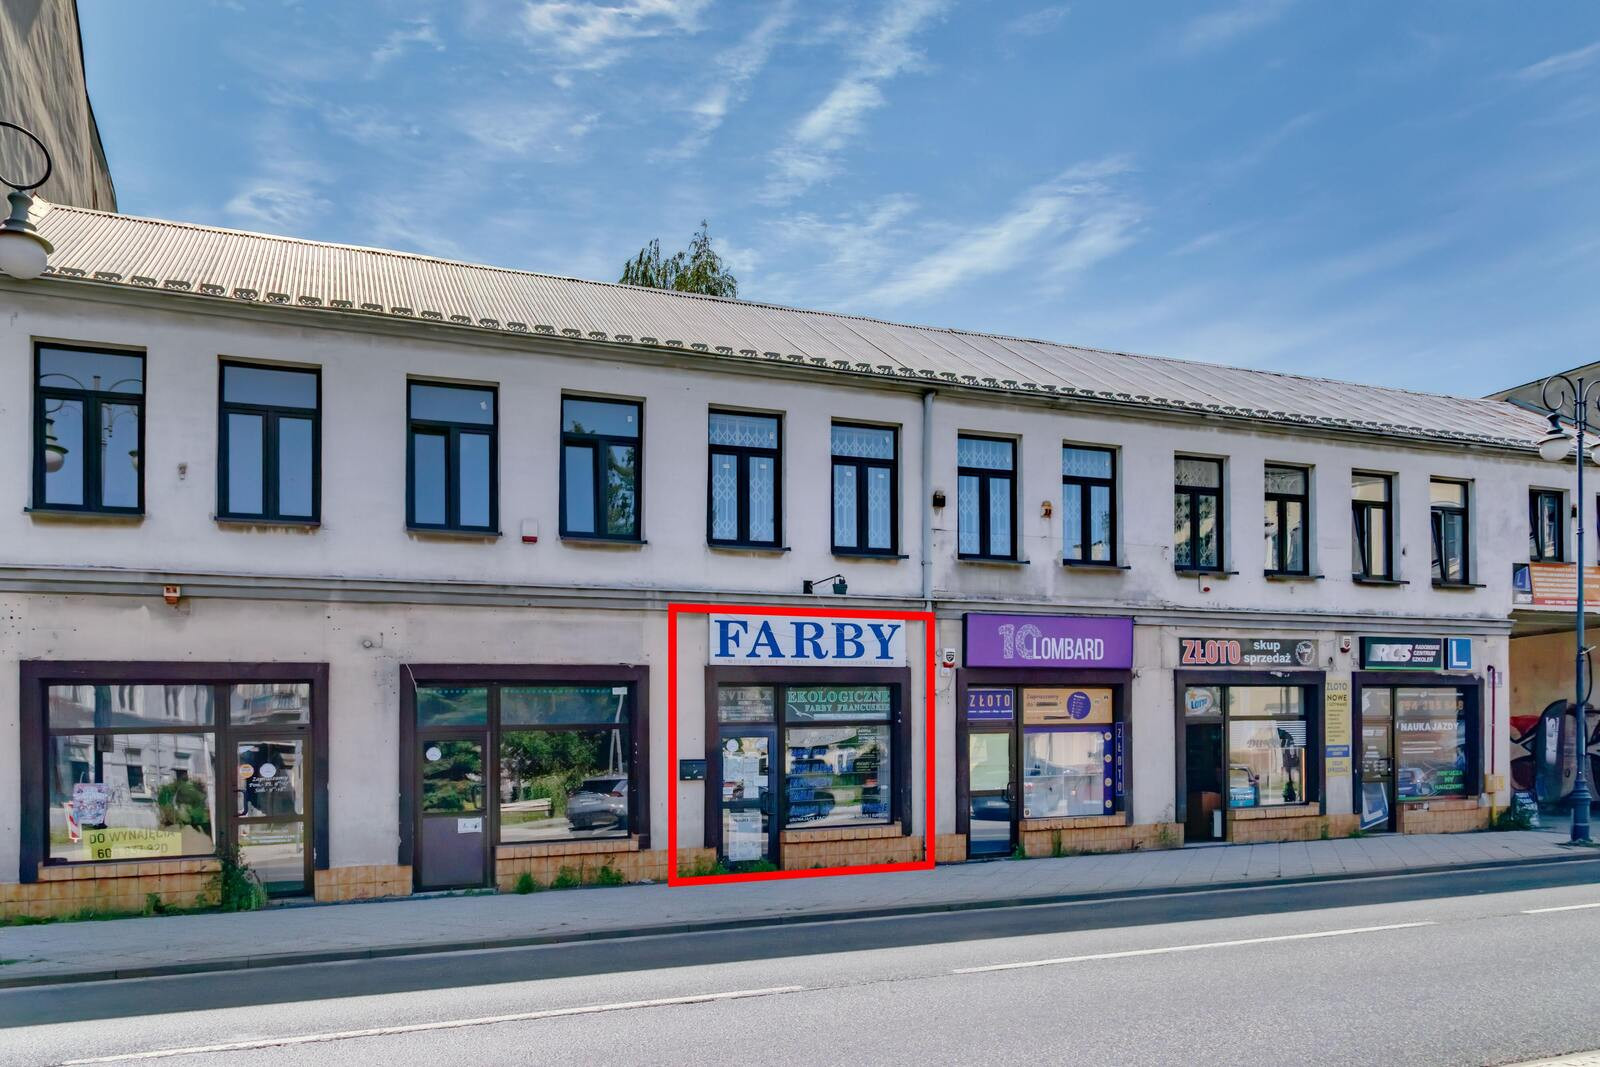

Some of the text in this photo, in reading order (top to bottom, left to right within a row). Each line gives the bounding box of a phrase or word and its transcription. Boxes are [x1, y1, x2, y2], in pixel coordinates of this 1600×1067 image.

[714, 619, 902, 660] FARBY
[1032, 637, 1104, 660] LOMBARD
[1182, 639, 1241, 665] ZŁOTO
[1253, 640, 1281, 652] skup
[1244, 653, 1291, 665] sprzedaż
[787, 690, 891, 703] EKOLOGICZNE
[969, 694, 1011, 707] ZŁOTO
[805, 703, 890, 712] FARBY FRANCUSKIE
[1400, 721, 1459, 731] NAUKA JAZDY
[90, 832, 105, 844] DO
